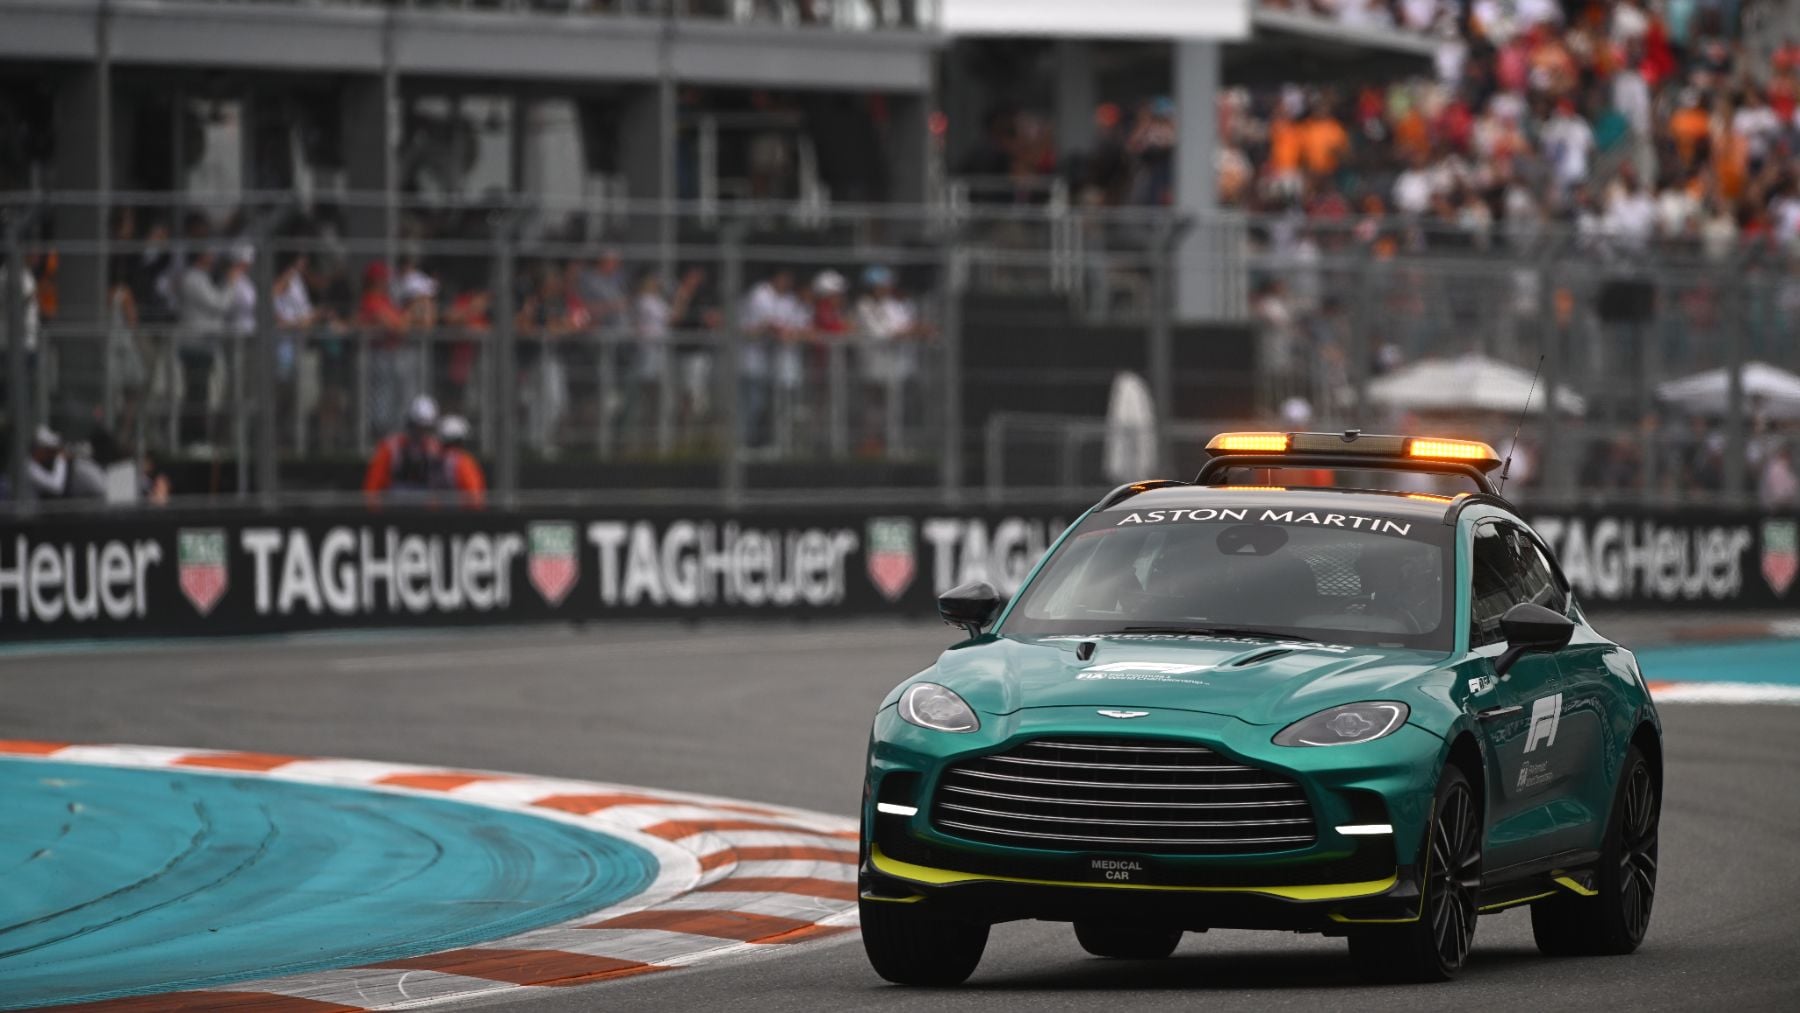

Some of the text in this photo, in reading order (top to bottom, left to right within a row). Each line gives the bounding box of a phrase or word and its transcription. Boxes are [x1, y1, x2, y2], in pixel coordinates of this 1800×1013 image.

[1117, 508, 1411, 536] ASTON MARTIN
[1091, 860, 1142, 870] MEDICAL
[1105, 871, 1129, 880] CAR
